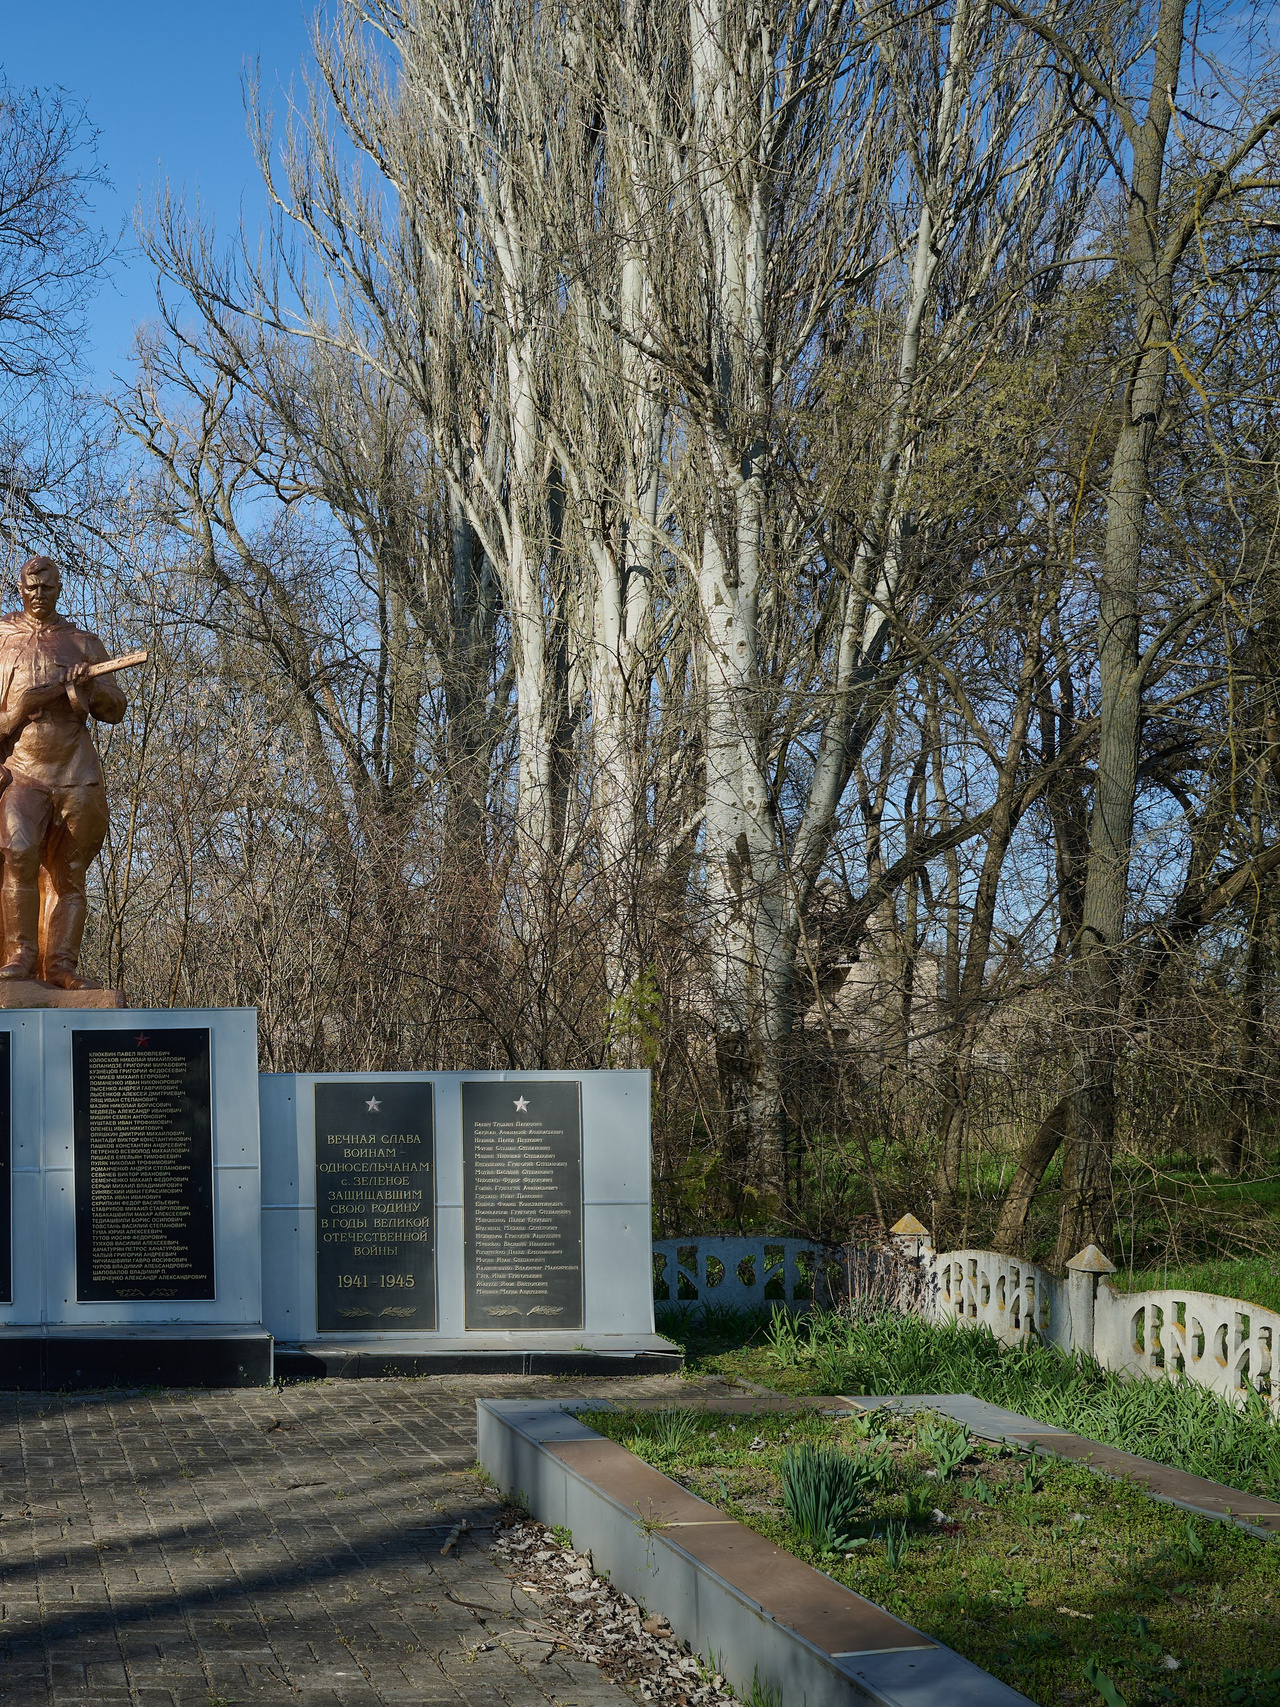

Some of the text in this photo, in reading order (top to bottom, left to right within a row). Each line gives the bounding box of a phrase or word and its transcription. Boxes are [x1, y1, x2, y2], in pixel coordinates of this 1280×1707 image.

[328, 1135, 421, 1144] ВЕЧНАЯ СЛАВА
[344, 1149, 395, 1157] ВОИНАМ
[320, 1163, 429, 1173] ОДНОСЕЛЬЧАНАМ
[354, 1176, 409, 1185] ЗЕЛЕНОЕ
[329, 1190, 422, 1200] ЗАЩИЩАВШИМ
[331, 1203, 420, 1214] СВОЮ РОДИНУ
[322, 1217, 429, 1229] В ГОДЫ ВЕЛИКОЙ
[324, 1230, 427, 1242] ОТЕЧЕСТВЕННОЙ
[354, 1245, 397, 1255] ВОЙНЫ
[338, 1275, 367, 1287] 1941
[381, 1275, 414, 1287] 1945
